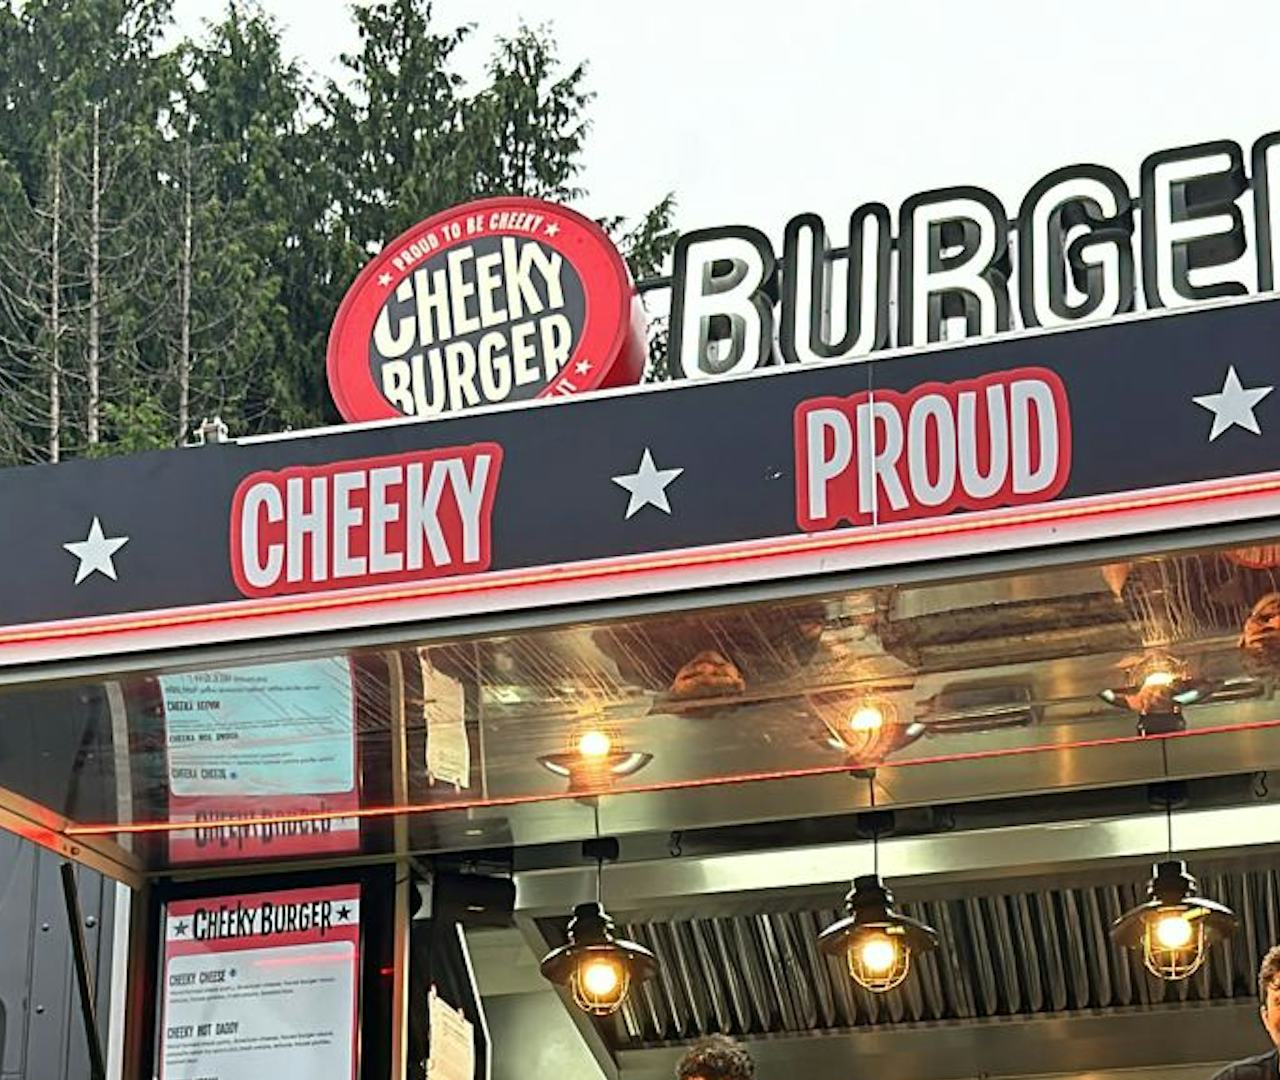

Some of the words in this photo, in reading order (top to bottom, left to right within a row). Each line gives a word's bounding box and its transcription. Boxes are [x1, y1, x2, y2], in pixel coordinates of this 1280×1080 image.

[391, 234, 439, 272] PROUD
[441, 221, 462, 243] TO
[466, 214, 485, 234] BE
[489, 211, 543, 234] CHEEKY
[373, 237, 564, 358] CHEEKY
[381, 314, 572, 417] BURGER
[241, 454, 492, 590] CHEEKY
[807, 379, 1060, 520] PROUD
[194, 901, 258, 940] CHEEKY
[261, 901, 333, 936] BURGER
[169, 972, 196, 986] CHEEKY
[199, 969, 226, 984] CHEESE
[167, 1025, 193, 1039] CHEEKY
